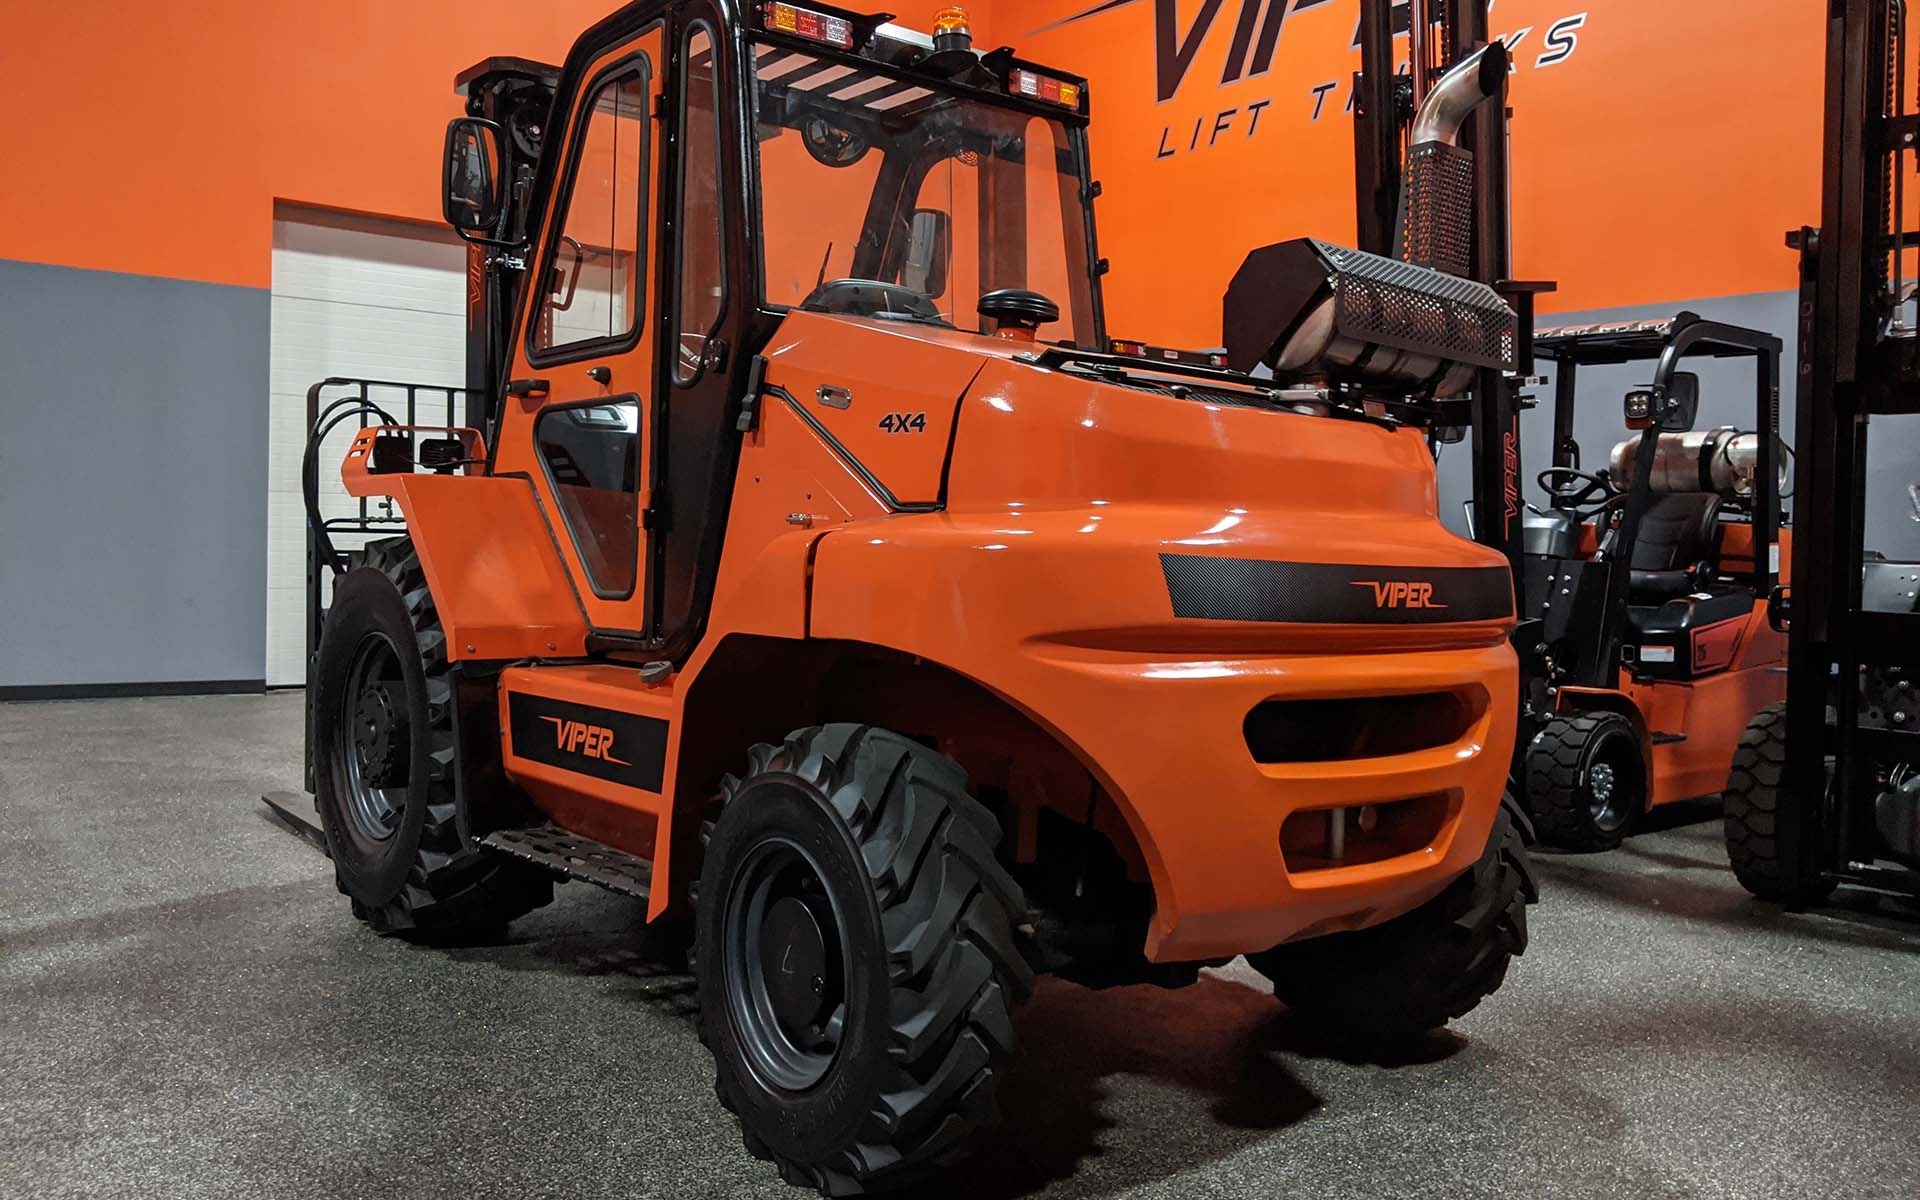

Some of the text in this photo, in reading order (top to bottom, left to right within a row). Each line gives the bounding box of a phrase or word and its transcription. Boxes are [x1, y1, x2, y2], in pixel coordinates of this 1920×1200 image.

[1156, 99, 1272, 158] LIFT
[878, 412, 927, 433] 4X4
[1503, 415, 1518, 541] VIPER
[1349, 581, 1449, 608] VIPER
[538, 715, 633, 766] VIPER
